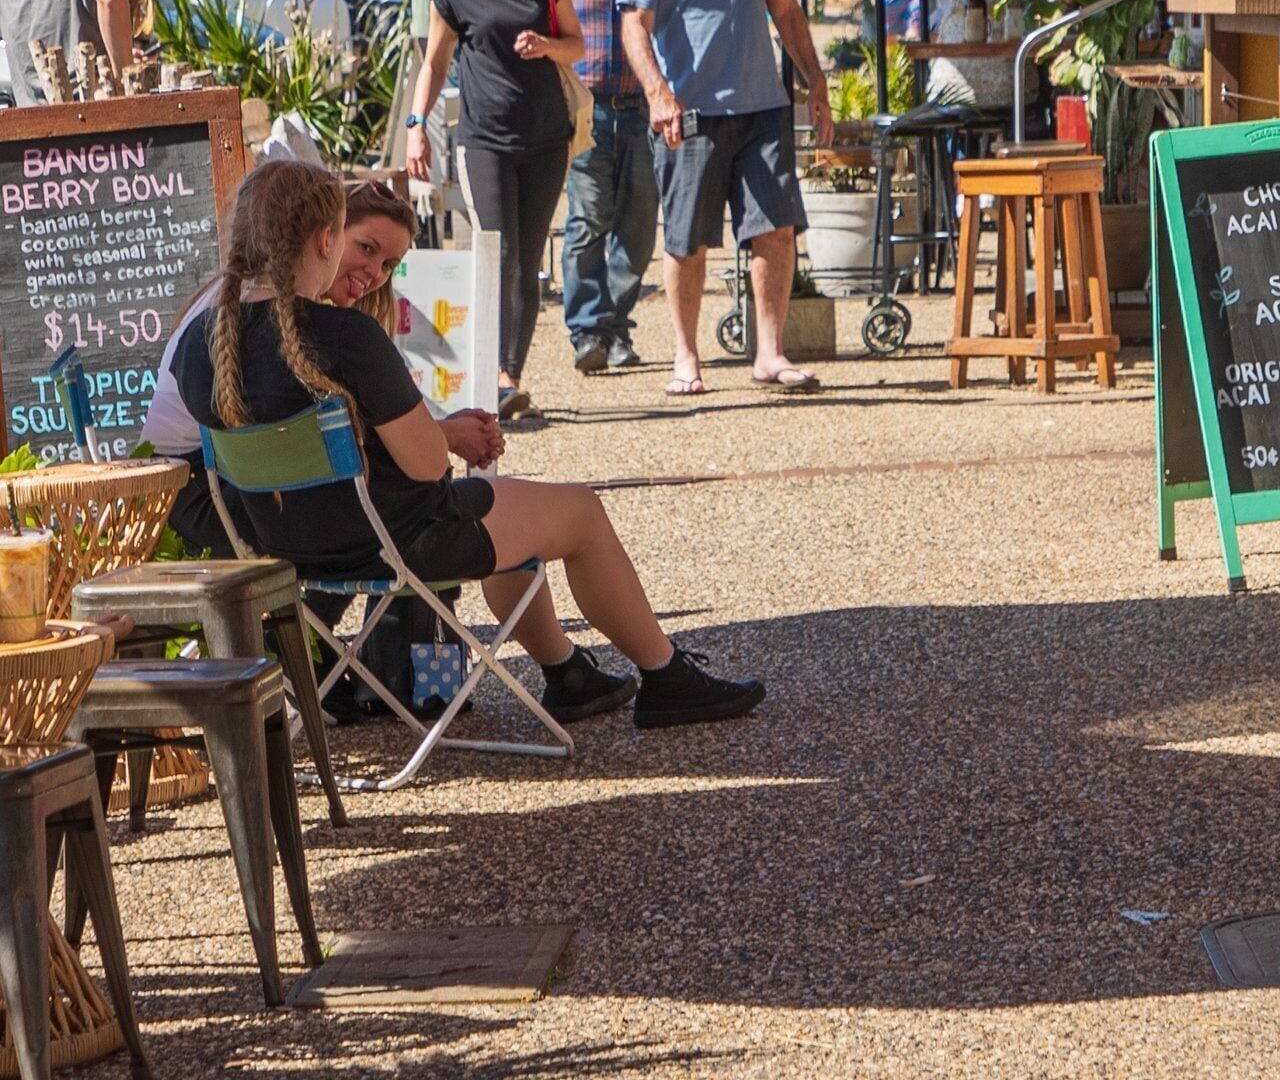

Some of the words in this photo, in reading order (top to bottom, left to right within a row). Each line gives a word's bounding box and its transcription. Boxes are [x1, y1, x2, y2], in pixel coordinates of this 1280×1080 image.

[23, 137, 154, 178] BANGIN'
[2, 178, 100, 215] BERRY
[112, 172, 195, 204] BOWL
[20, 212, 98, 236] banana,
[100, 206, 156, 227] berry
[163, 205, 174, 218] +
[20, 230, 100, 254] coconut
[105, 227, 164, 245] cream
[168, 218, 212, 237] base
[1226, 209, 1278, 237] ACAI
[24, 253, 65, 271] with
[72, 242, 146, 269] seasonal
[154, 238, 200, 261] fruit,
[26, 268, 97, 294] granola
[102, 271, 113, 282] +
[117, 259, 186, 281] coconut
[29, 290, 97, 310] cream
[105, 281, 176, 305] drizzle
[43, 308, 162, 352] $14.50
[31, 368, 161, 404] TOPICA
[1216, 382, 1271, 411] ACAI
[11, 401, 135, 435] SQUZE
[40, 437, 127, 462] orage
